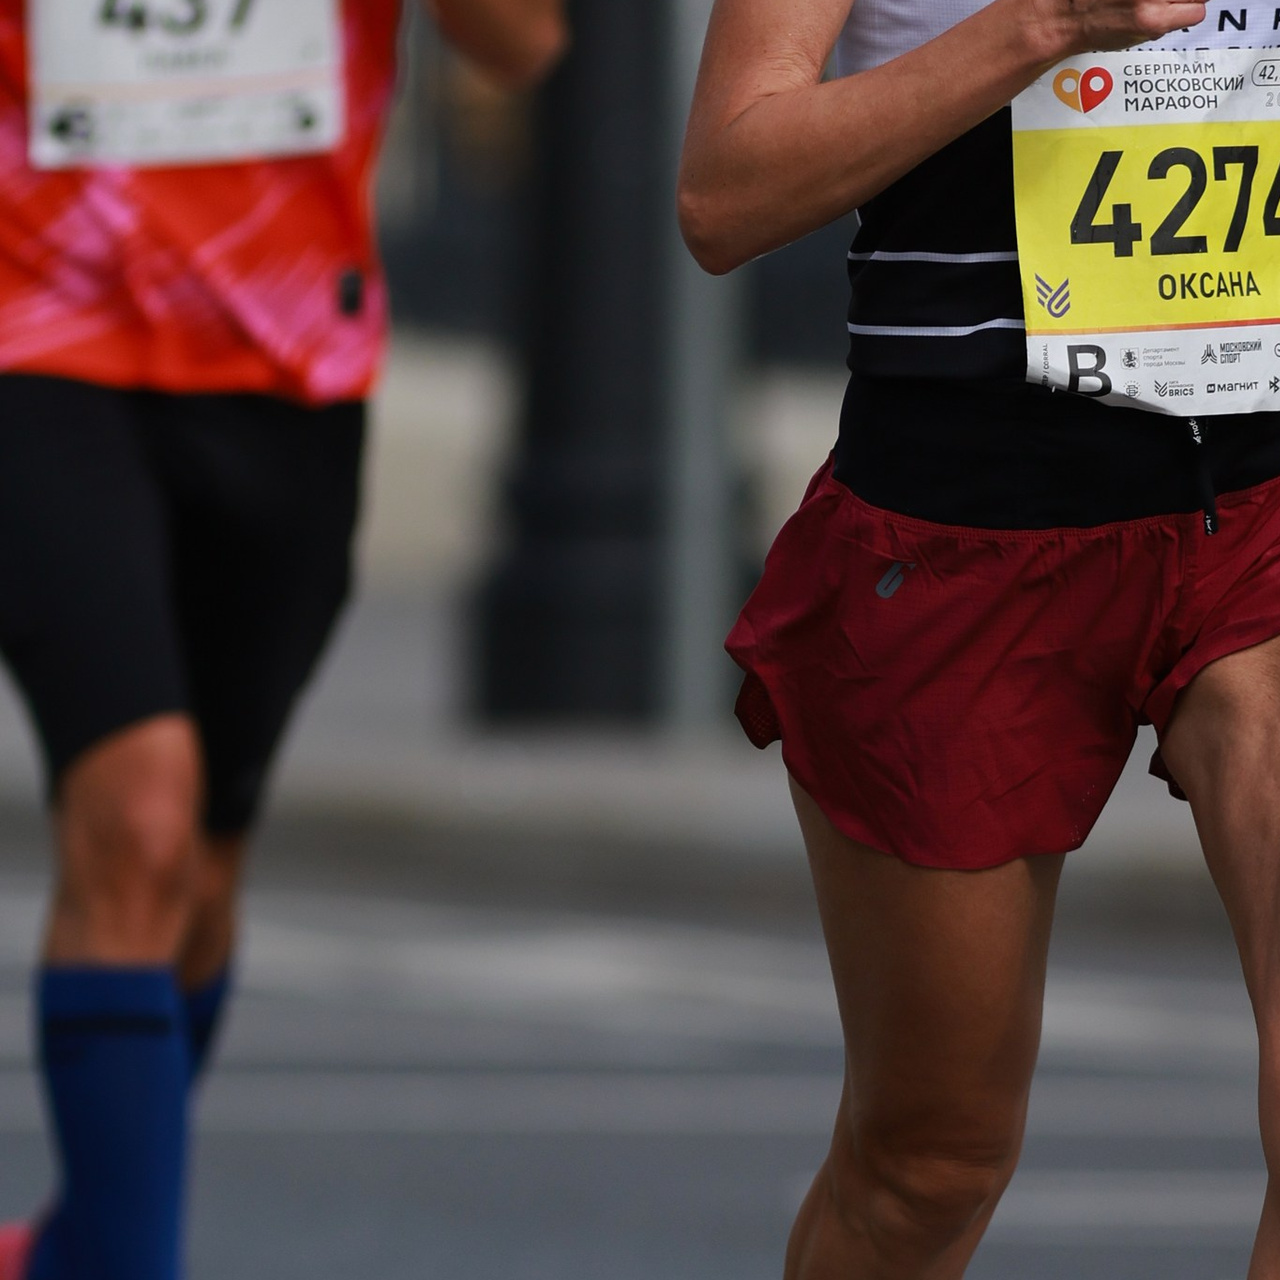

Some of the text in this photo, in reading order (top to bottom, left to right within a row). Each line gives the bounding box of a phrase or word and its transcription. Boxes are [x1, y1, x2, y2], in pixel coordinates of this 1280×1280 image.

[1123, 60, 1216, 77] СБЕРПРАЙМ
[1123, 74, 1245, 94] МОСКОВСКИЙ
[1124, 94, 1218, 112] МАРАФОН
[1158, 270, 1261, 301] ОКСАНА
[1220, 339, 1262, 352] МОСКОВСКИЙ
[1220, 353, 1241, 364] СПОРТ
[1168, 387, 1194, 397] BRICS
